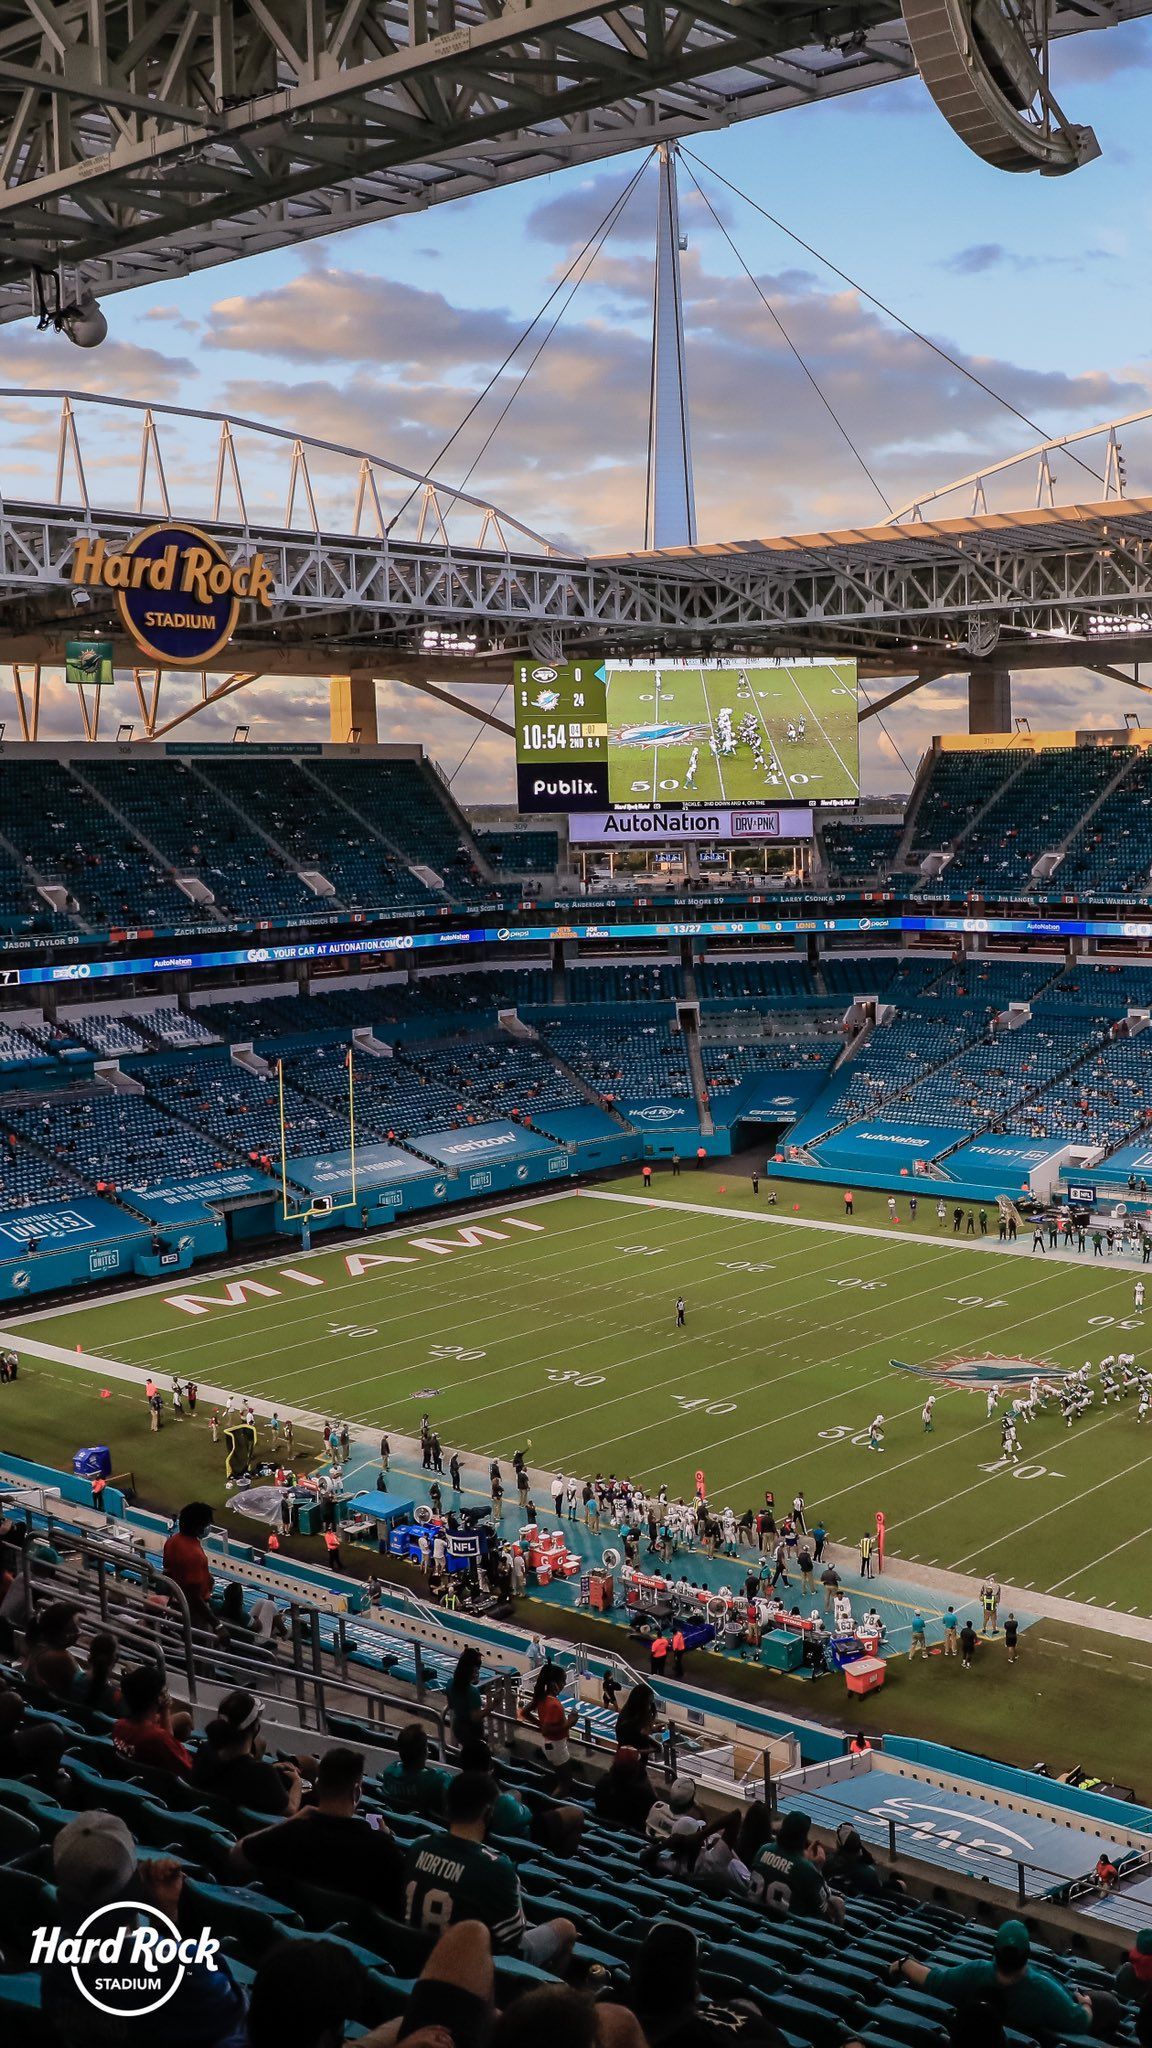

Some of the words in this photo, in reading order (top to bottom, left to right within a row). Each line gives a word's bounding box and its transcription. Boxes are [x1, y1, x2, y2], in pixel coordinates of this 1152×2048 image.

[72, 538, 178, 591] Hard
[181, 548, 274, 607] Rock
[144, 612, 215, 630] STADIUM
[574, 668, 581, 682] 0
[573, 693, 584, 707] 24
[523, 724, 567, 750] 10:54
[570, 738, 584, 749] 2ND
[595, 738, 600, 748] 4
[603, 814, 719, 832] AutoNation
[572, 901, 604, 909] ANDERSON
[780, 895, 801, 903] LARRY
[805, 894, 834, 902] CSONKA
[174, 928, 194, 937] ZACH
[196, 925, 227, 935] THOMAS
[228, 924, 238, 933] 54
[674, 925, 701, 933] 13/27
[731, 924, 743, 932] 90
[775, 923, 782, 931] 0
[823, 921, 835, 929] 18
[1026, 923, 1060, 932] AutoNation
[440, 932, 470, 941] AutoNation
[509, 930, 529, 938] pepsi
[3, 941, 30, 949] JASON
[33, 938, 66, 947] TAYLOR
[67, 936, 79, 944] 99
[273, 948, 296, 958] YOUR
[298, 947, 315, 956] CAR
[317, 946, 327, 954] AT
[153, 958, 192, 967] AutoNation
[629, 1108, 657, 1117] Hard
[658, 1107, 685, 1116] Rock
[443, 1132, 510, 1154] verizon
[856, 1132, 931, 1147] AutoNation
[970, 1145, 1022, 1157] TRUIST
[137, 1189, 176, 1200] THANKS
[186, 1183, 205, 1192] ALL
[12, 1212, 56, 1225] FOOTBALL
[11, 1216, 80, 1237] UNITES
[93, 1255, 116, 1268] UNITES
[165, 1218, 544, 1314] MIAMI
[328, 1325, 378, 1338] 10
[429, 1346, 487, 1361] 20
[548, 1370, 606, 1387] 30
[678, 1397, 737, 1415] 40
[977, 1459, 1047, 1480] 40
[453, 1542, 476, 1552] NFL
[541, 1556, 549, 1565] G
[557, 1556, 564, 1564] G
[841, 1622, 851, 1630] 63
[865, 1616, 875, 1626] 78
[864, 1642, 873, 1651] G
[416, 1851, 465, 1882] NORTON
[760, 1850, 793, 1874] MOORE
